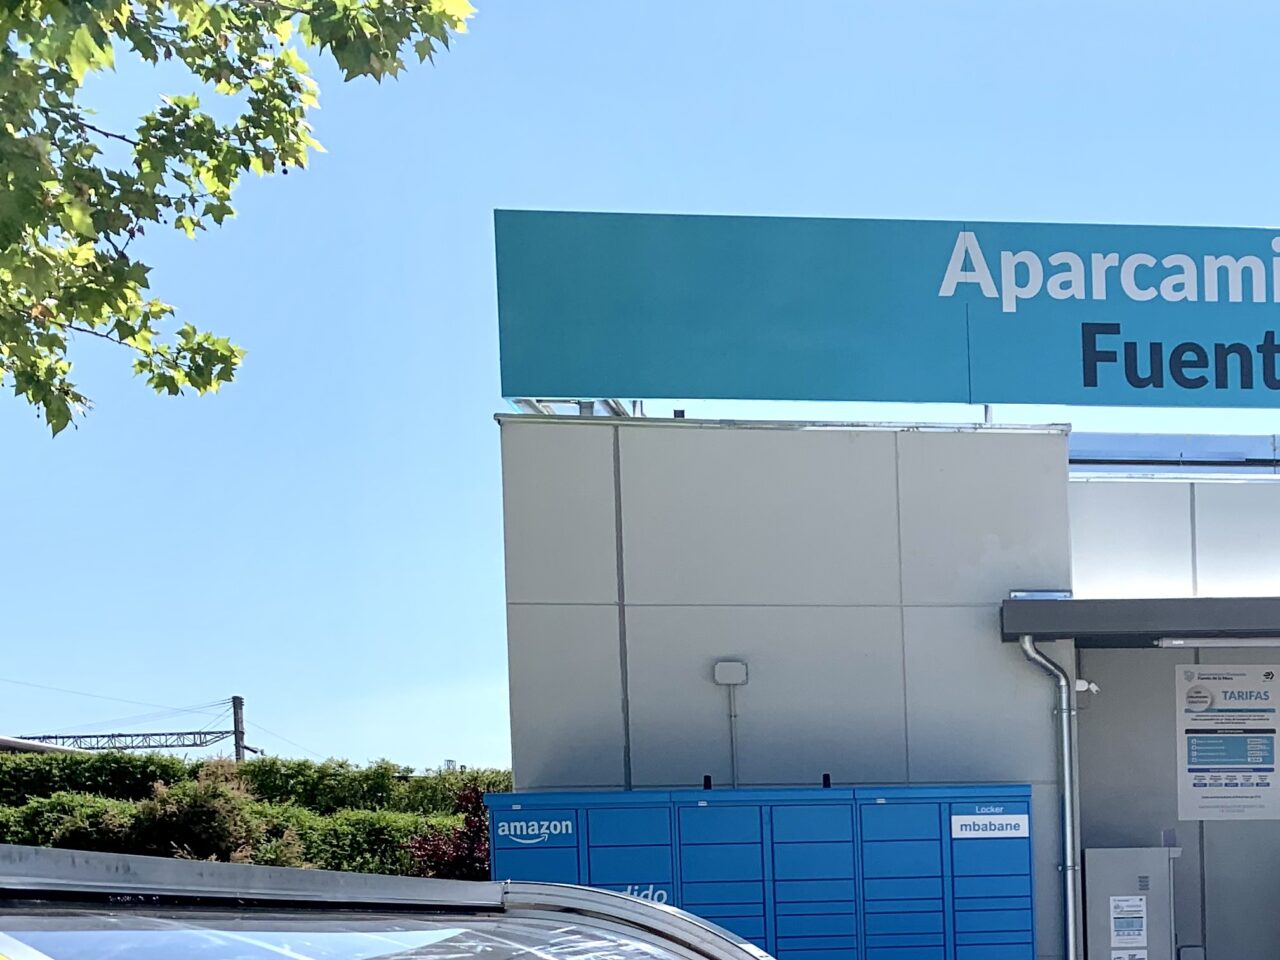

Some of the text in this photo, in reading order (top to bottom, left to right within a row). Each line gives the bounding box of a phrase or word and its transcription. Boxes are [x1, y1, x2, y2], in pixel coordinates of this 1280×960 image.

[1221, 690, 1270, 701] TARIFAS
[975, 805, 1005, 814] Locker
[497, 820, 573, 836] amazon
[960, 821, 1021, 832] mbabane
